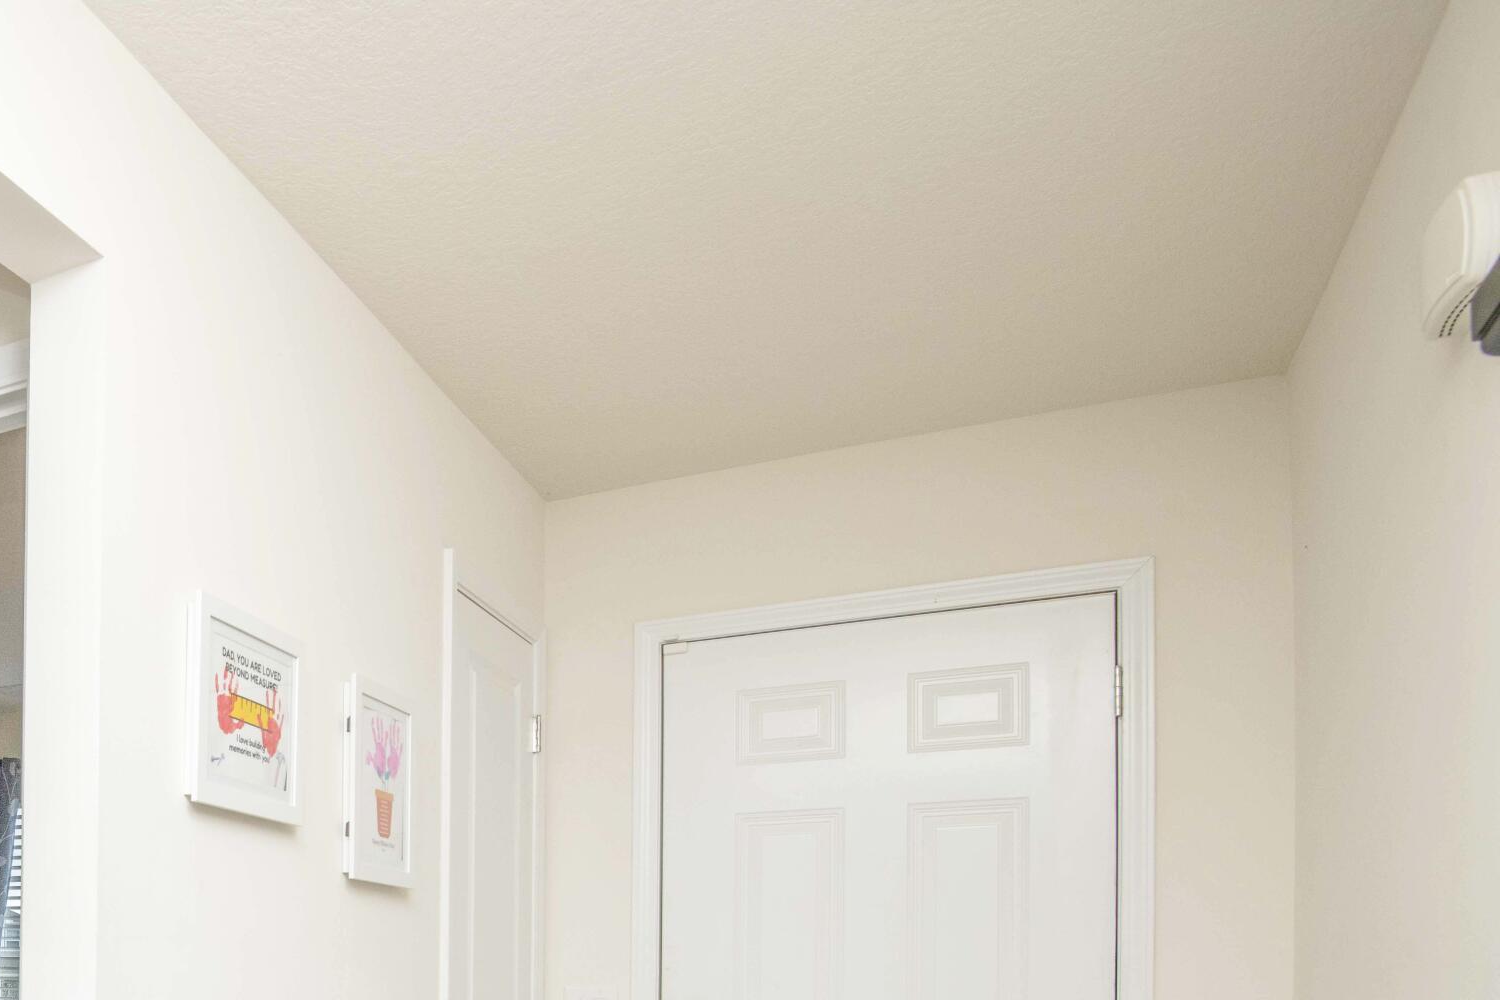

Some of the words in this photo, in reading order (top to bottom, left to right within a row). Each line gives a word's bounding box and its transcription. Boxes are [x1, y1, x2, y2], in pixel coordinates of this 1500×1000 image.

[225, 662, 249, 681] BEYOND
[236, 653, 250, 668] YOU
[250, 661, 262, 674] ARE
[262, 665, 282, 682] LOVED
[228, 744, 252, 758] memories
